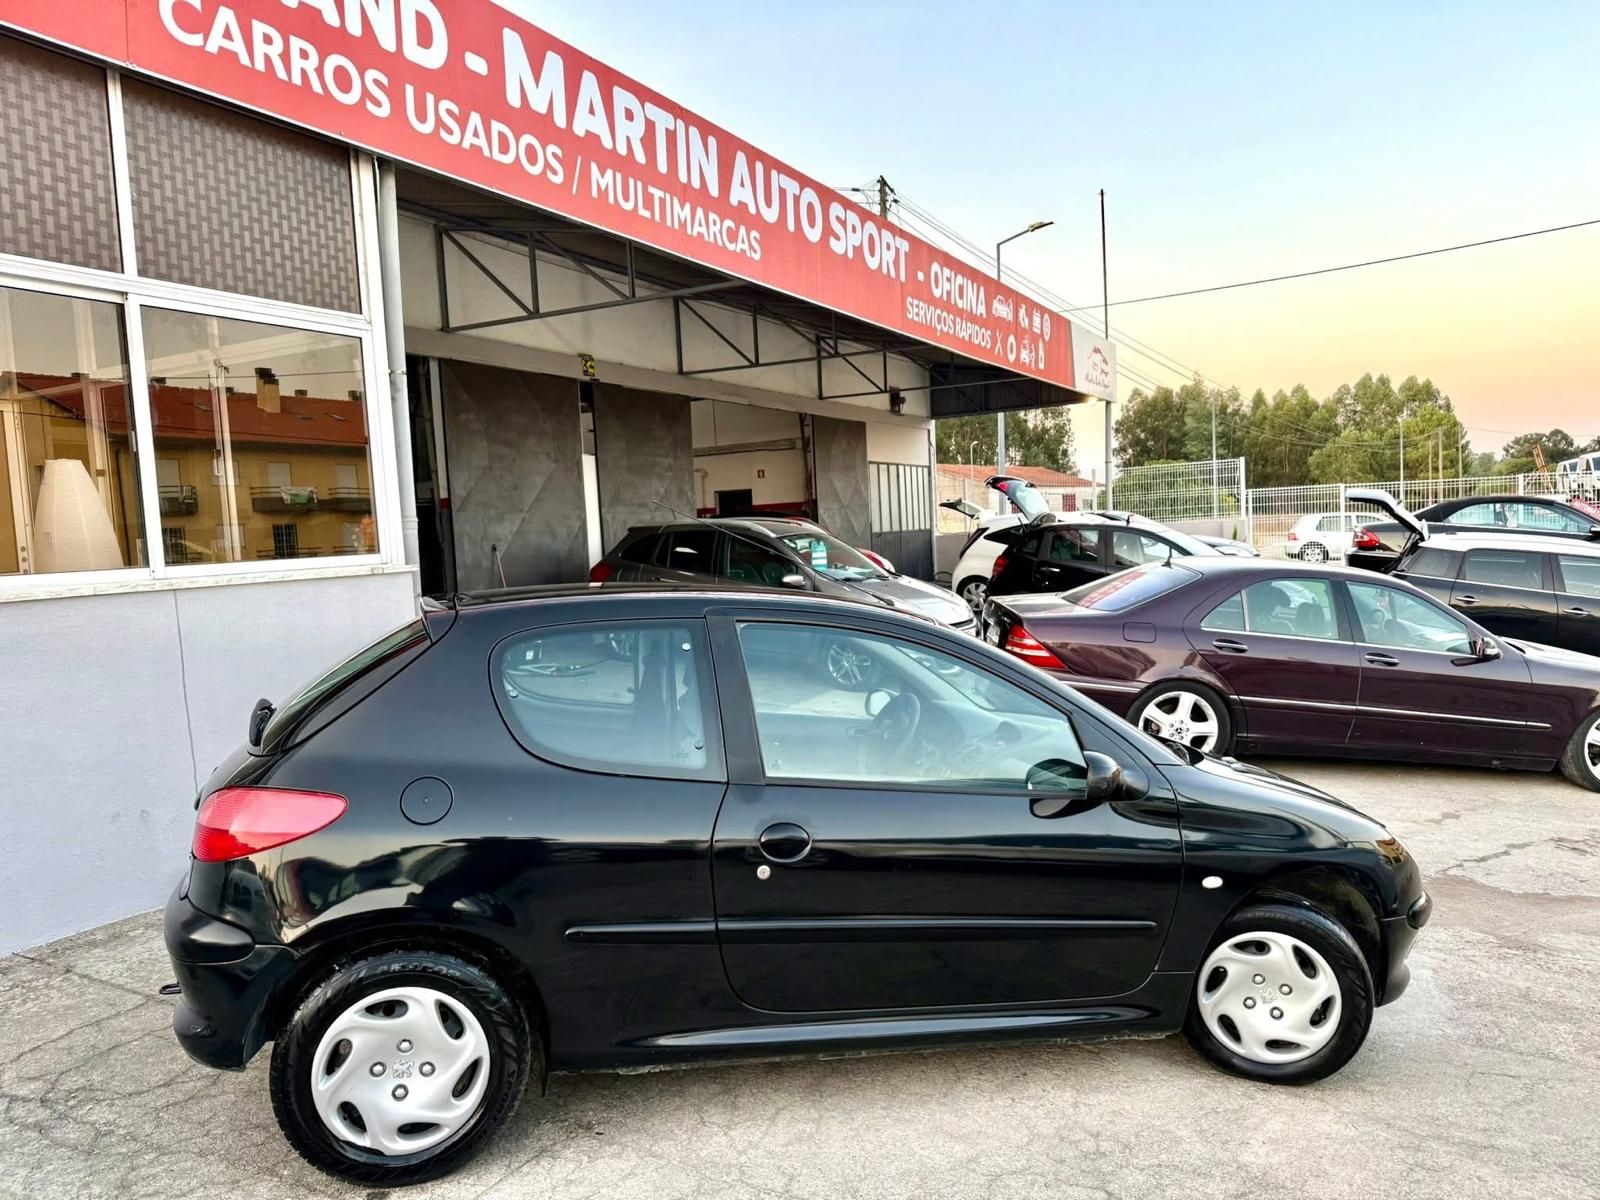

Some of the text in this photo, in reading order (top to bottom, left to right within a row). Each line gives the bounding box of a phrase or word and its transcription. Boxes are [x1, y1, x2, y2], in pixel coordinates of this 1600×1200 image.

[158, 0, 762, 261] CARROS USADOS / MULTIMARCAS
[502, 27, 719, 198] MARTIN
[729, 151, 823, 243] AUTO
[829, 201, 910, 283] SPORT
[930, 261, 987, 319] OFICINA
[906, 296, 992, 349] SERVIÇOS RÁPIDOS
